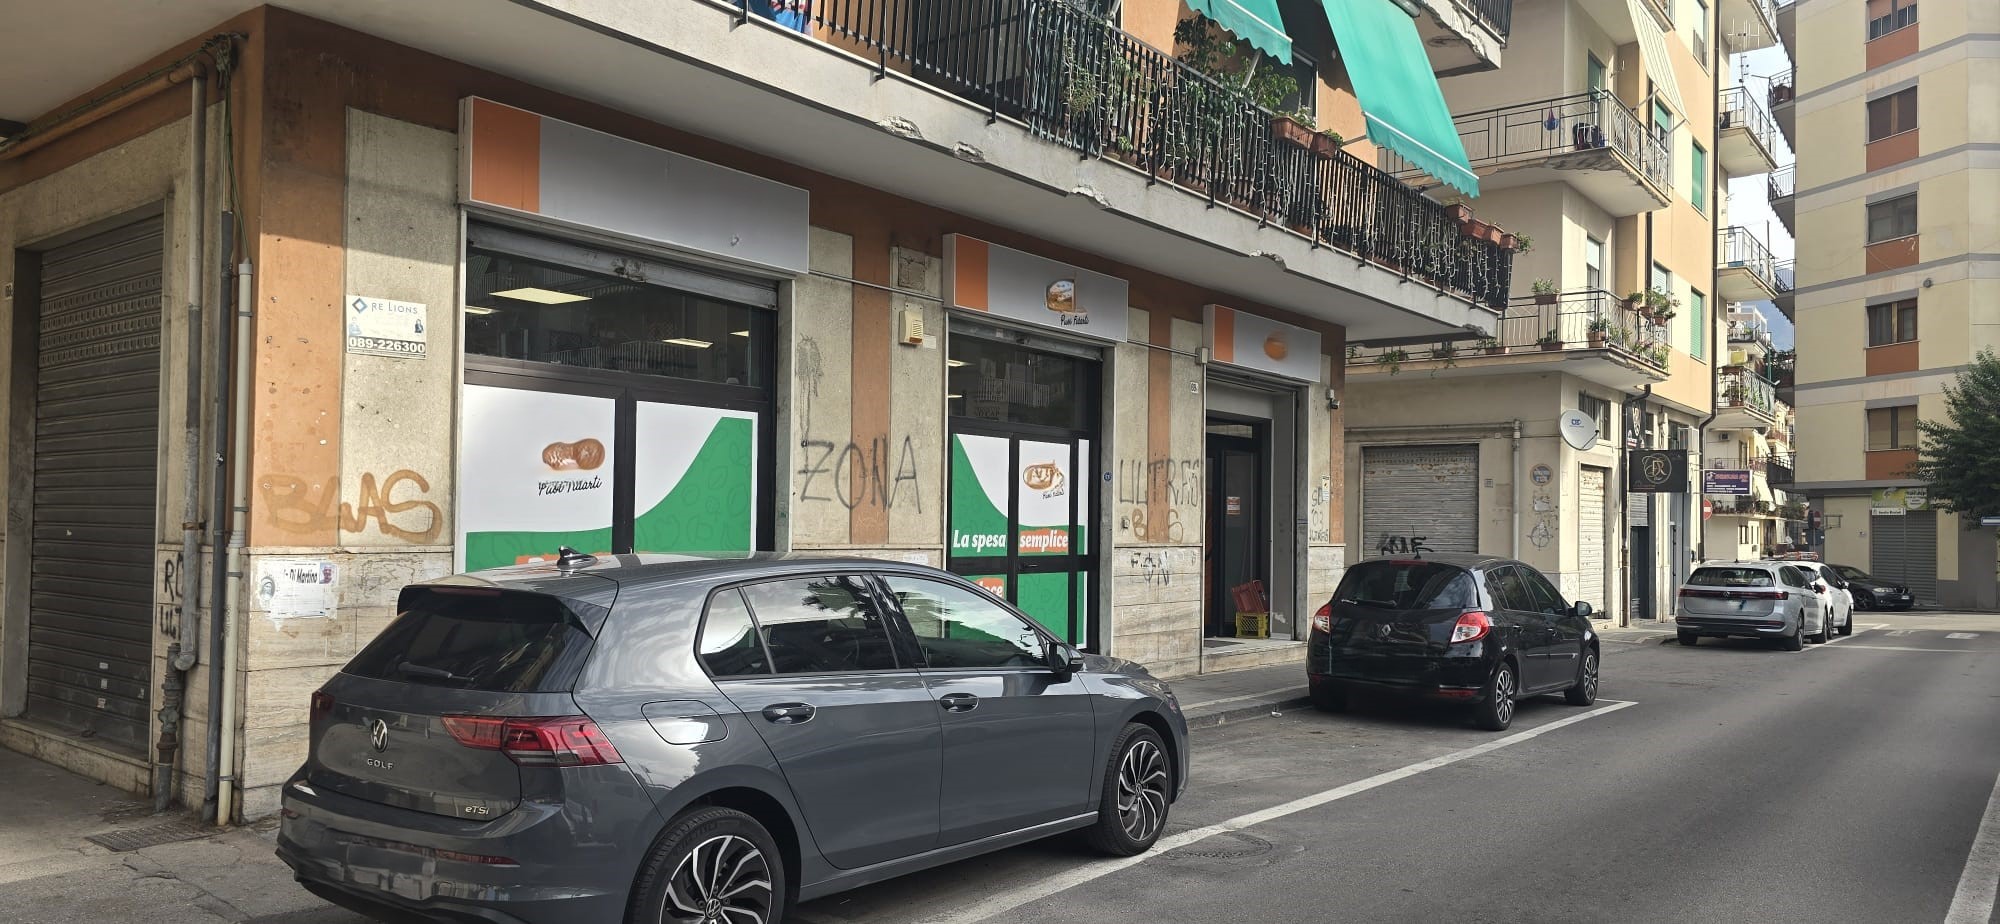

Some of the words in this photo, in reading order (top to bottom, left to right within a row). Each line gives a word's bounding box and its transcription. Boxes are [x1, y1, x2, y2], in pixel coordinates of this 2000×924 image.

[349, 337, 426, 353] 089-226300
[797, 433, 922, 514] ZONA
[953, 529, 969, 548] La
[972, 532, 1007, 553] spesa
[1020, 529, 1069, 553] semplice
[367, 758, 394, 770] GOLF
